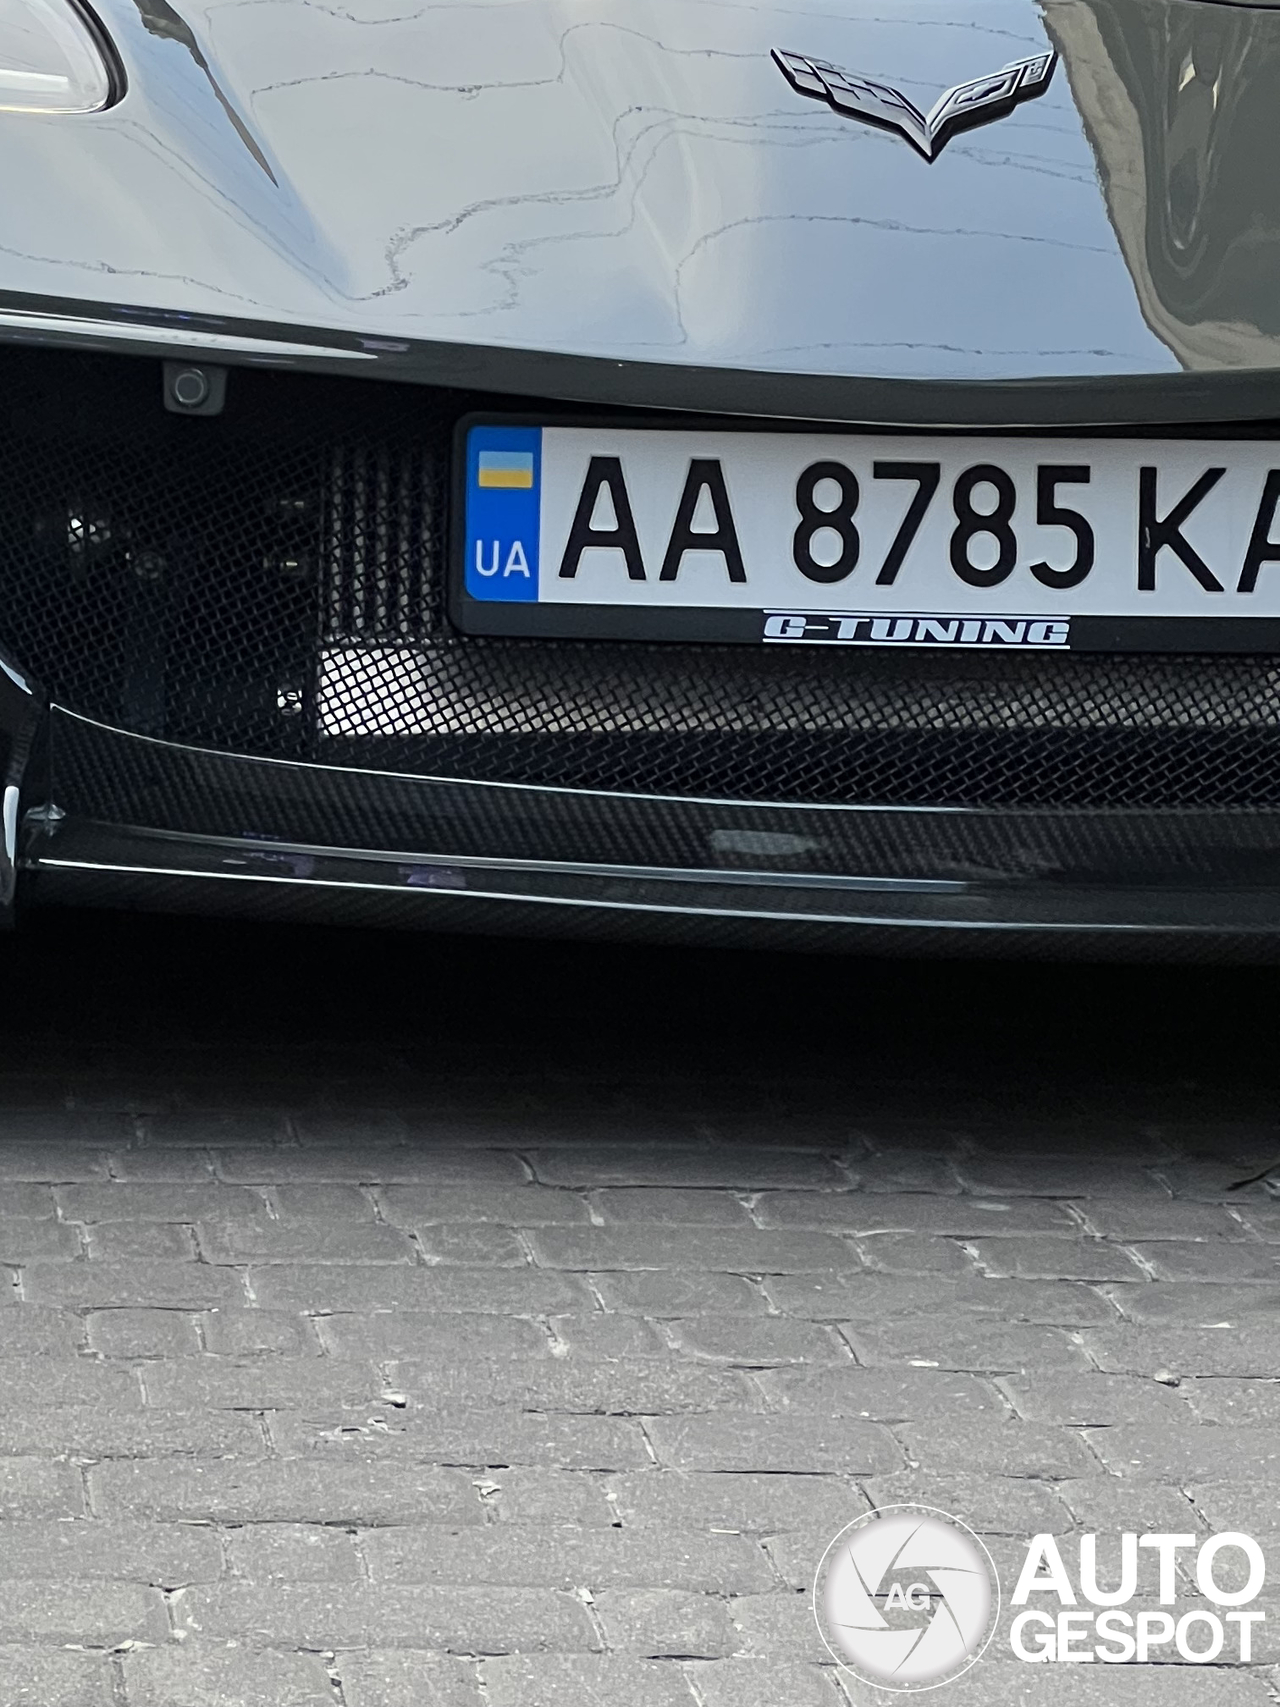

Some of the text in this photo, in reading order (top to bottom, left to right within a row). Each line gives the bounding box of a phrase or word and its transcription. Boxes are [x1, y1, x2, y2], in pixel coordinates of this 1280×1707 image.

[558, 455, 748, 583] AA
[792, 460, 1096, 590] 8785
[475, 539, 531, 578] UA
[763, 615, 1070, 644] G-TUNING
